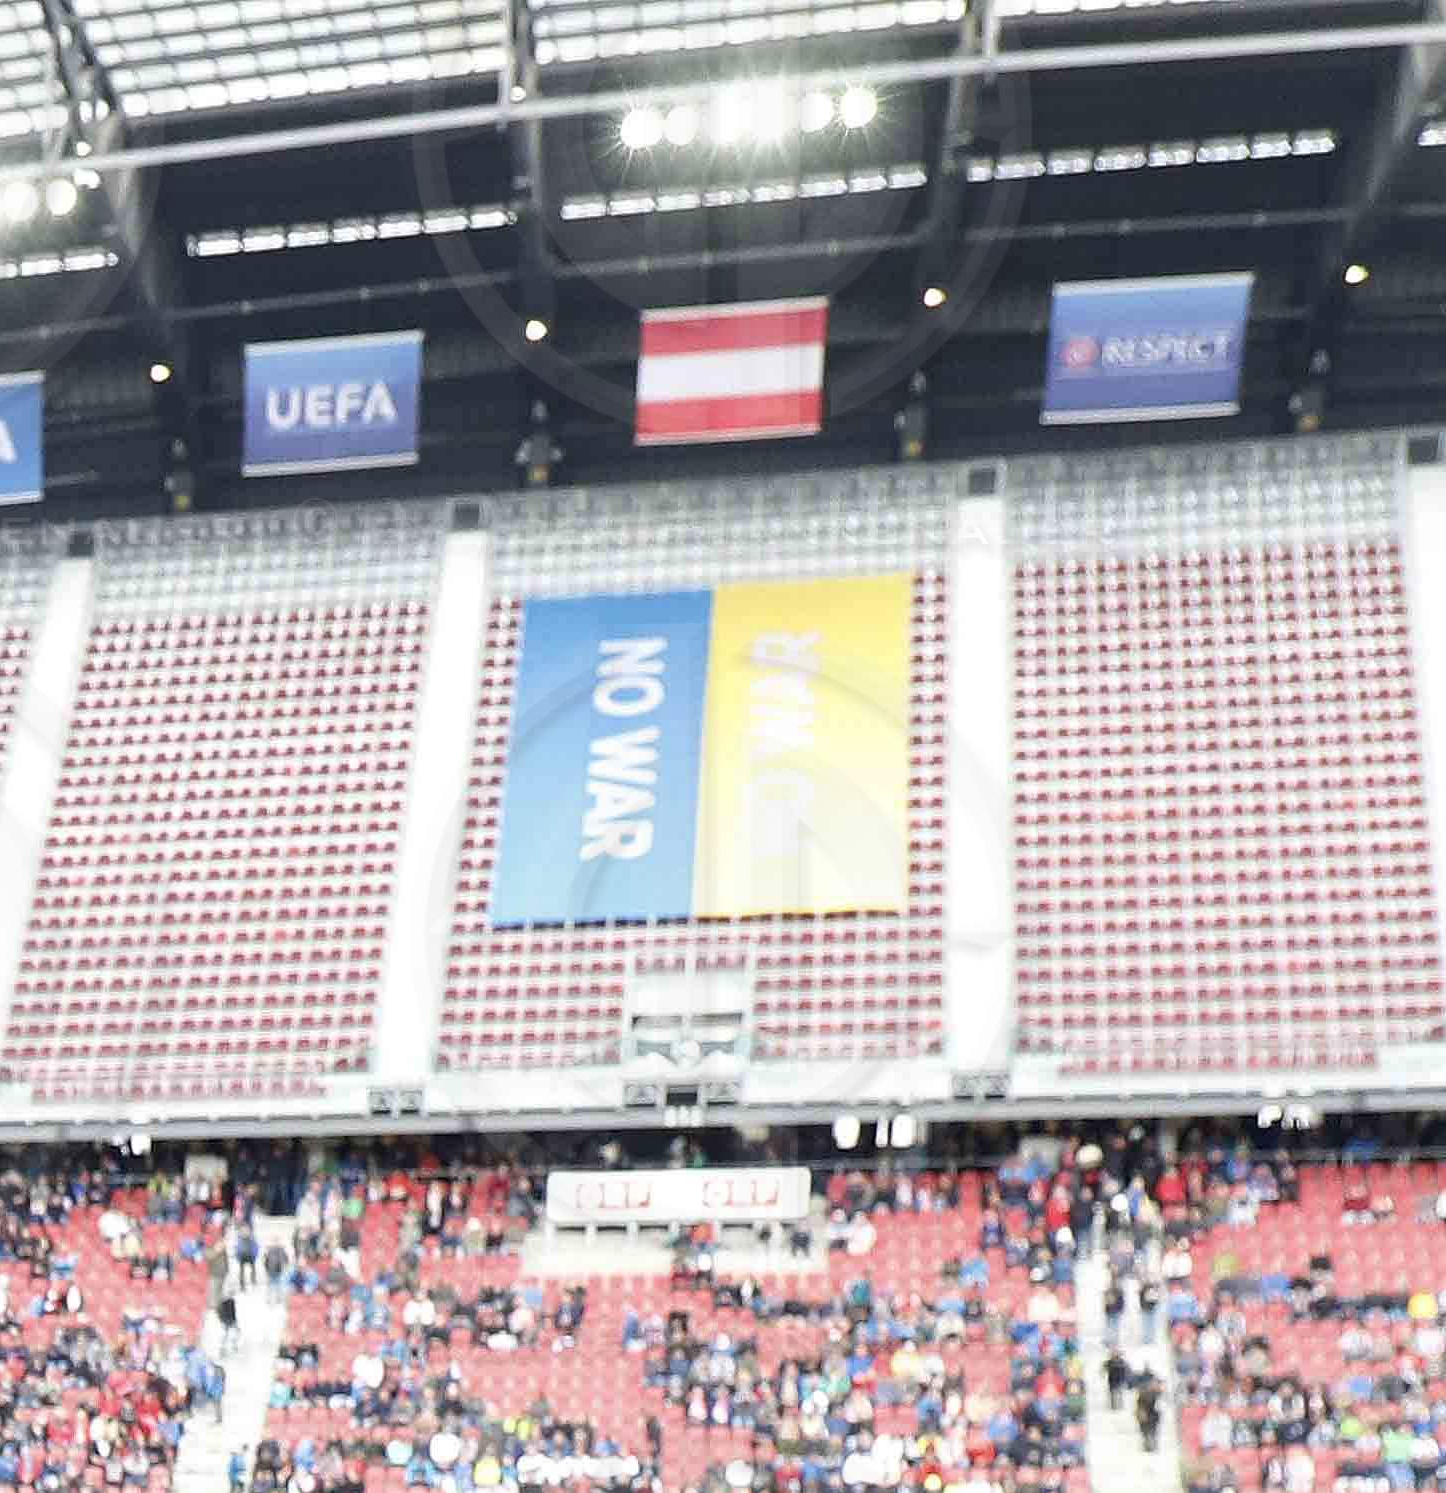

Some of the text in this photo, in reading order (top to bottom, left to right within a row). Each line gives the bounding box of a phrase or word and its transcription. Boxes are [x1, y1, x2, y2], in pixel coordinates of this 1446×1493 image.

[266, 382, 397, 431] UEFA
[579, 636, 669, 862] NO WAR
